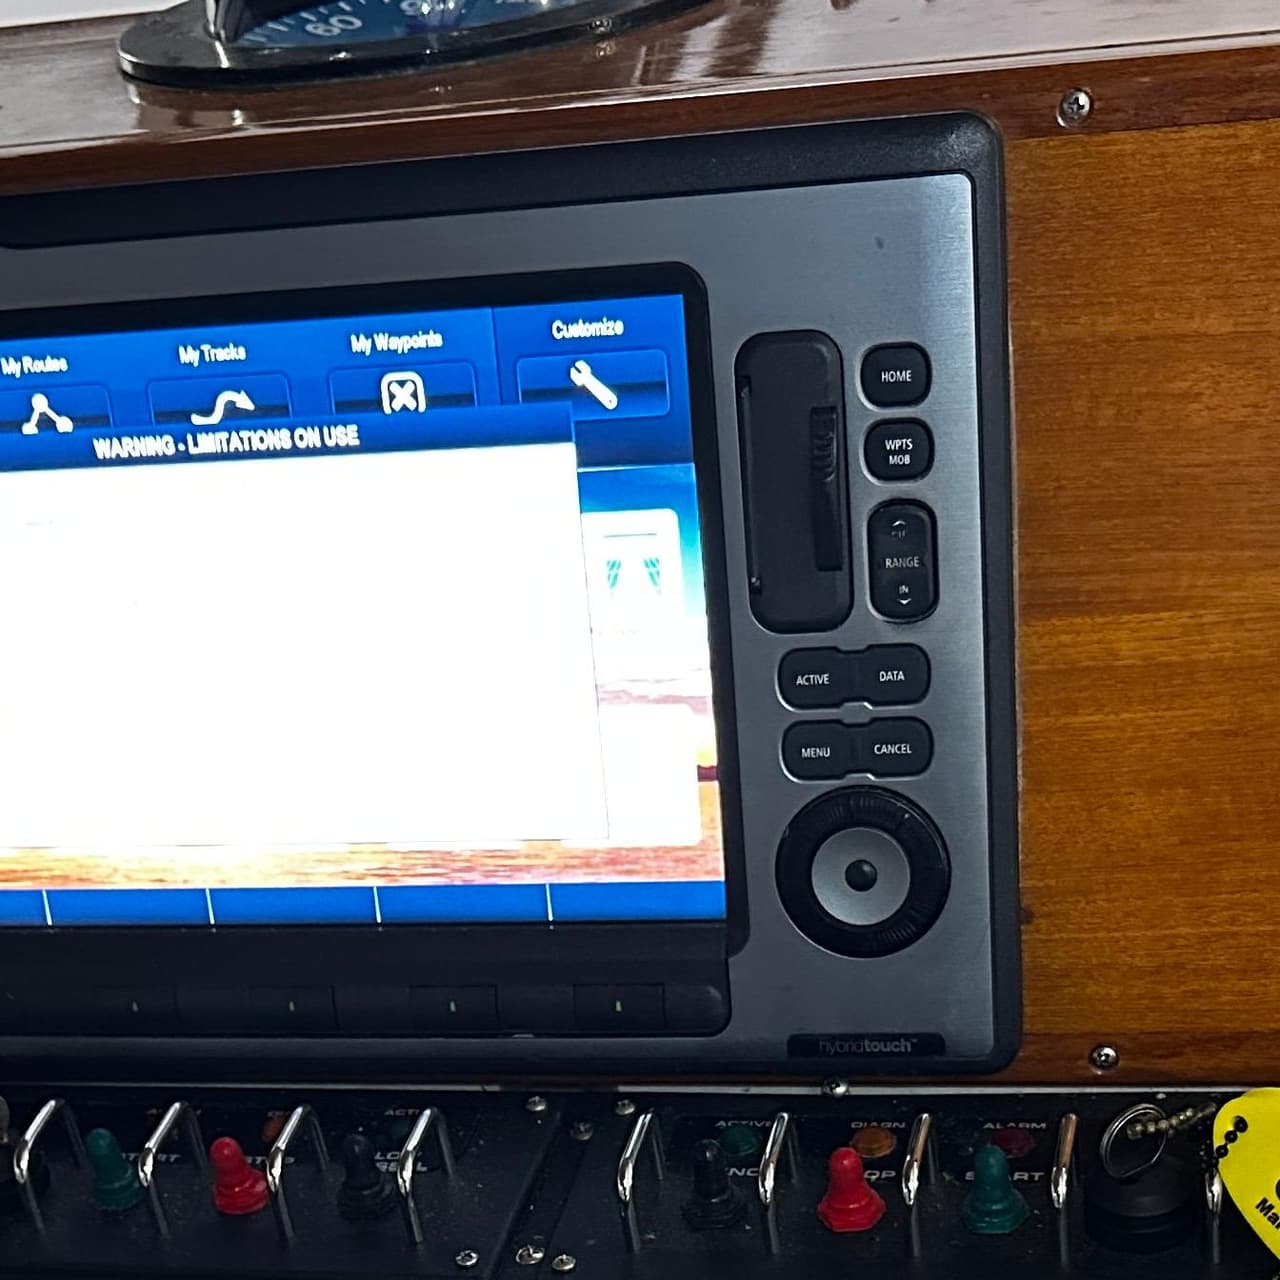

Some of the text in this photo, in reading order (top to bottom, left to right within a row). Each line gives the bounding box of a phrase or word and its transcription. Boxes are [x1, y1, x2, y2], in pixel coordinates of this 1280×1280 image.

[552, 317, 624, 340] Customize
[350, 329, 443, 356] My Waypoints
[178, 342, 247, 367] My Tracks
[0, 356, 68, 378] My Routes
[881, 370, 912, 383] HOME
[93, 434, 176, 459] WARNING
[186, 428, 292, 454] LIMITATIONS
[294, 426, 322, 449] ON
[323, 424, 360, 447] USE
[885, 439, 913, 451] WPTS
[889, 455, 911, 465] MOB
[885, 556, 920, 569] RANGE
[796, 673, 830, 686] ACTIVE
[879, 670, 905, 682] DATA
[801, 747, 831, 758] MENU
[873, 743, 912, 755] CANCEL
